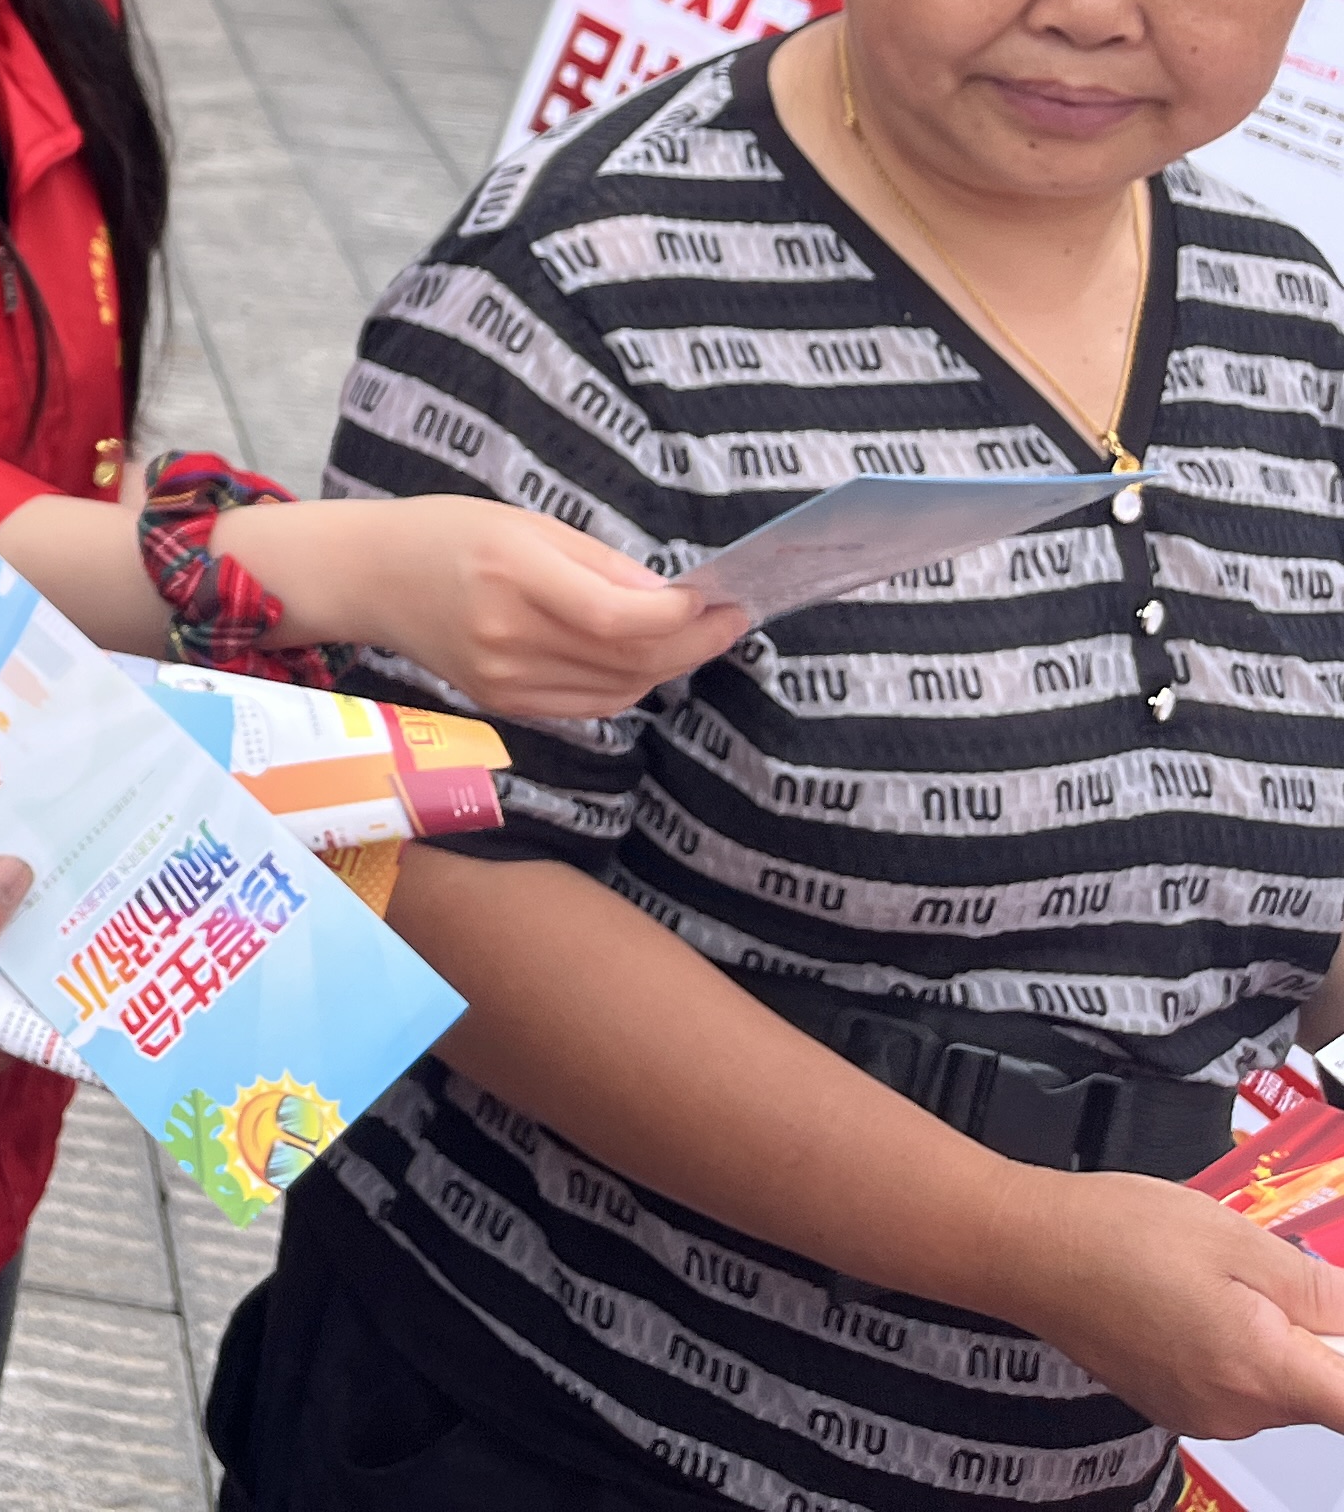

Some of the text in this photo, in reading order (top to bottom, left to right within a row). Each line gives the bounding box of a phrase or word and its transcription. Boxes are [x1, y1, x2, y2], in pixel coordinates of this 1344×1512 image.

[54, 818, 243, 1023] 预防溺水
[118, 849, 309, 1058] 珍爱生命
